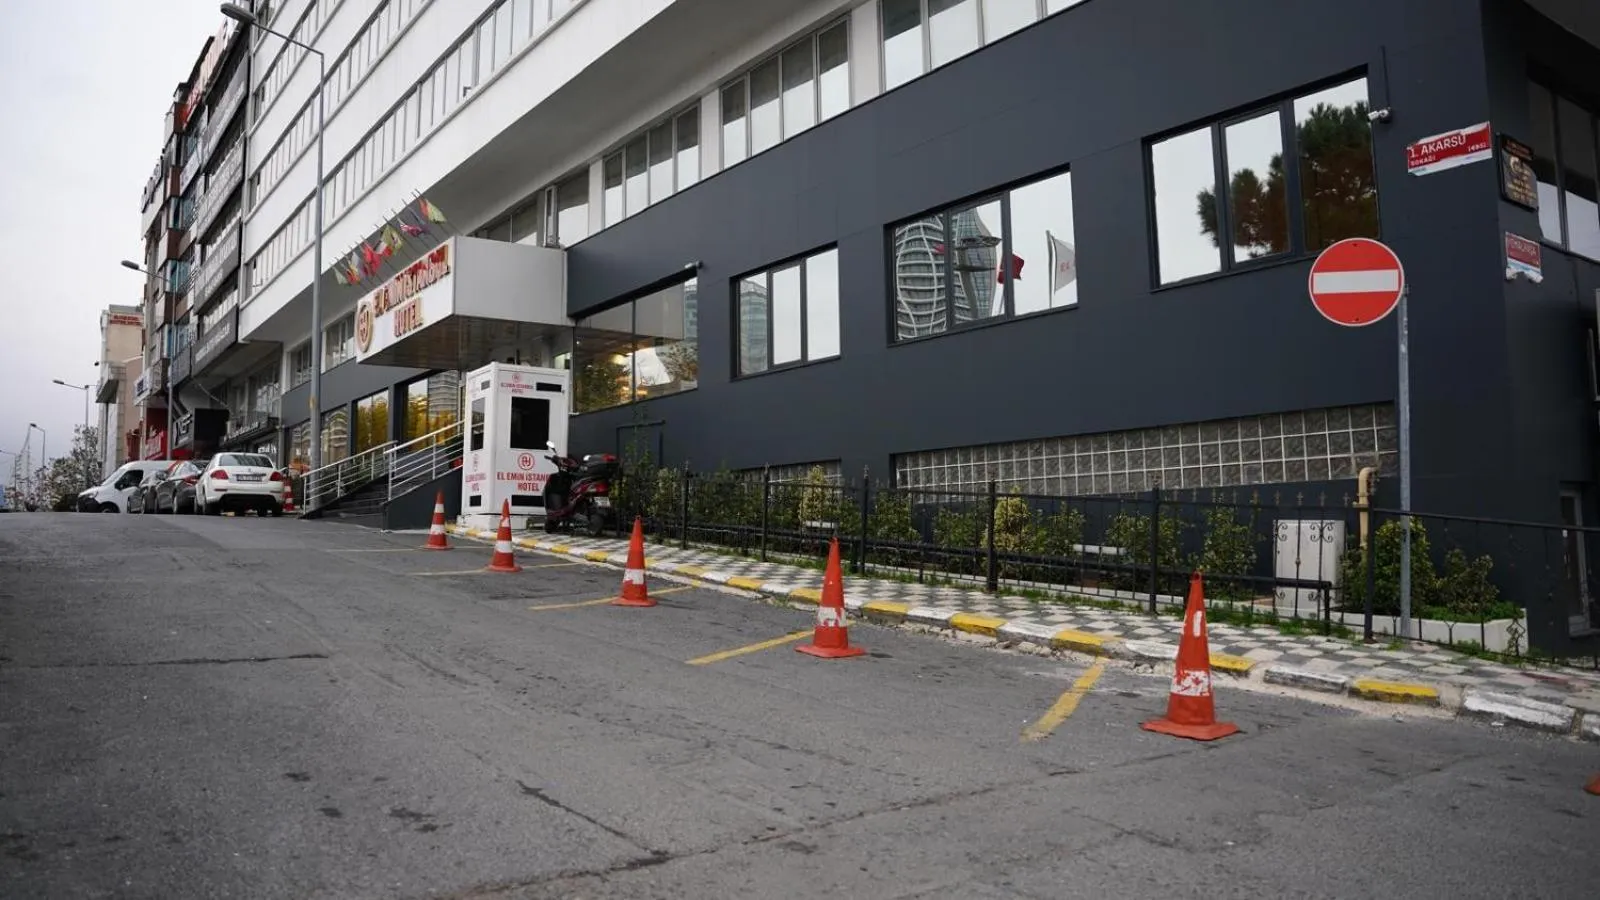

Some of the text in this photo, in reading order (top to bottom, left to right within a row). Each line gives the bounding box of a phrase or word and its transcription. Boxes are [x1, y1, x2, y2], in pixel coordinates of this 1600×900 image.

[1421, 135, 1466, 156] AKARSU
[497, 472, 505, 480] EL
[517, 482, 539, 492] HOTEL
